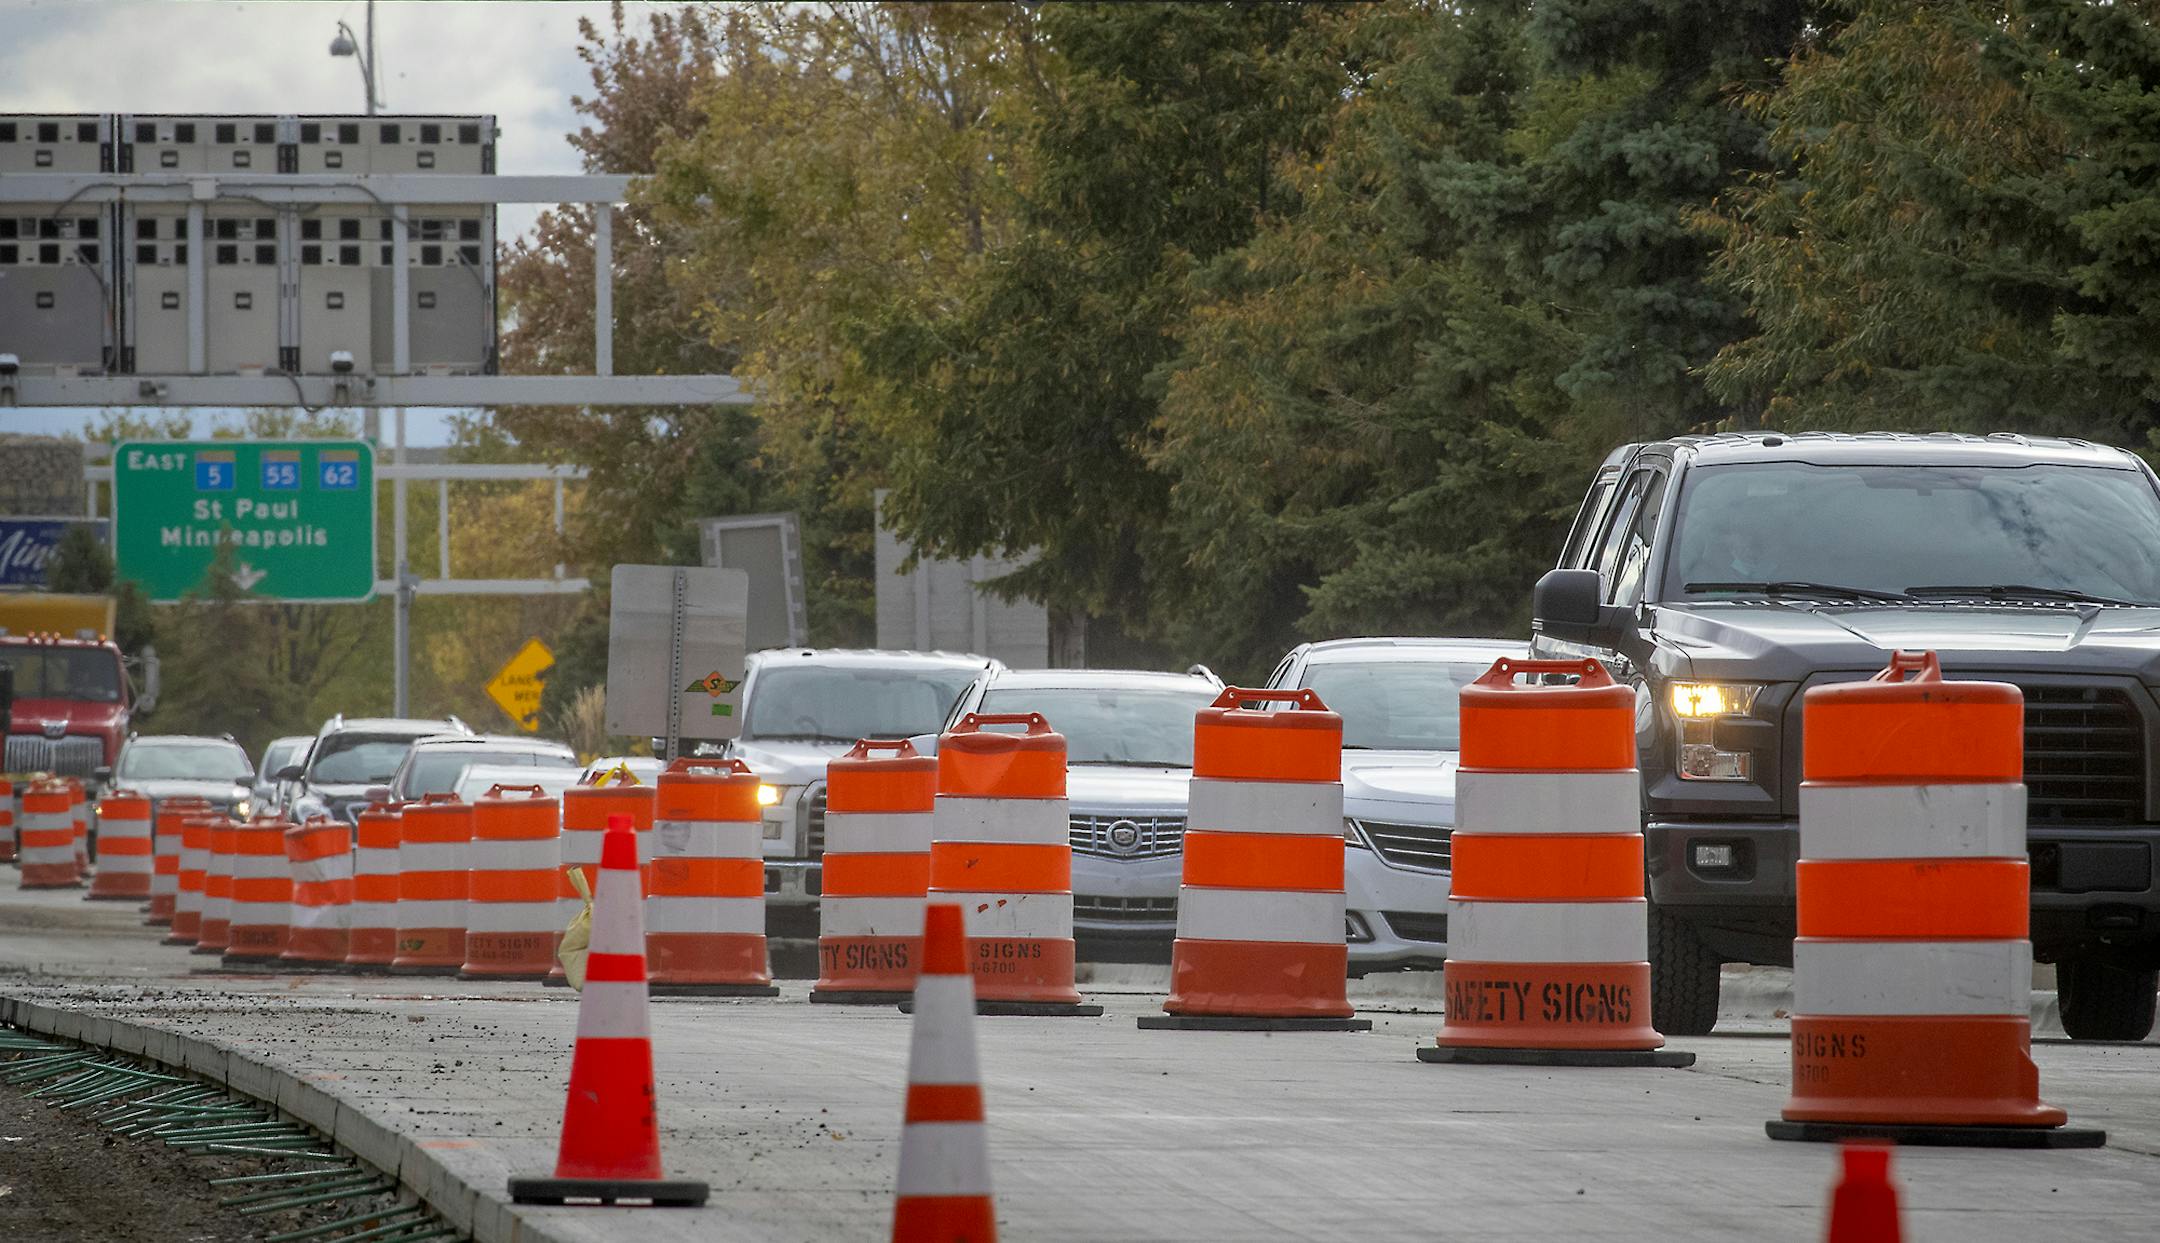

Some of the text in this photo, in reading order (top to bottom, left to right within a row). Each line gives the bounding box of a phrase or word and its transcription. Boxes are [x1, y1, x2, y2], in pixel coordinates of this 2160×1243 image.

[208, 465, 221, 485] 5
[266, 465, 295, 485] 55
[324, 465, 353, 486] 62
[194, 499, 298, 519] St Paul
[846, 943, 908, 970] SIGNS
[980, 943, 1041, 959] SIGNS
[1446, 981, 1632, 1023] SAFETY SIGNS
[1796, 1032, 1865, 1058] SIGNS
